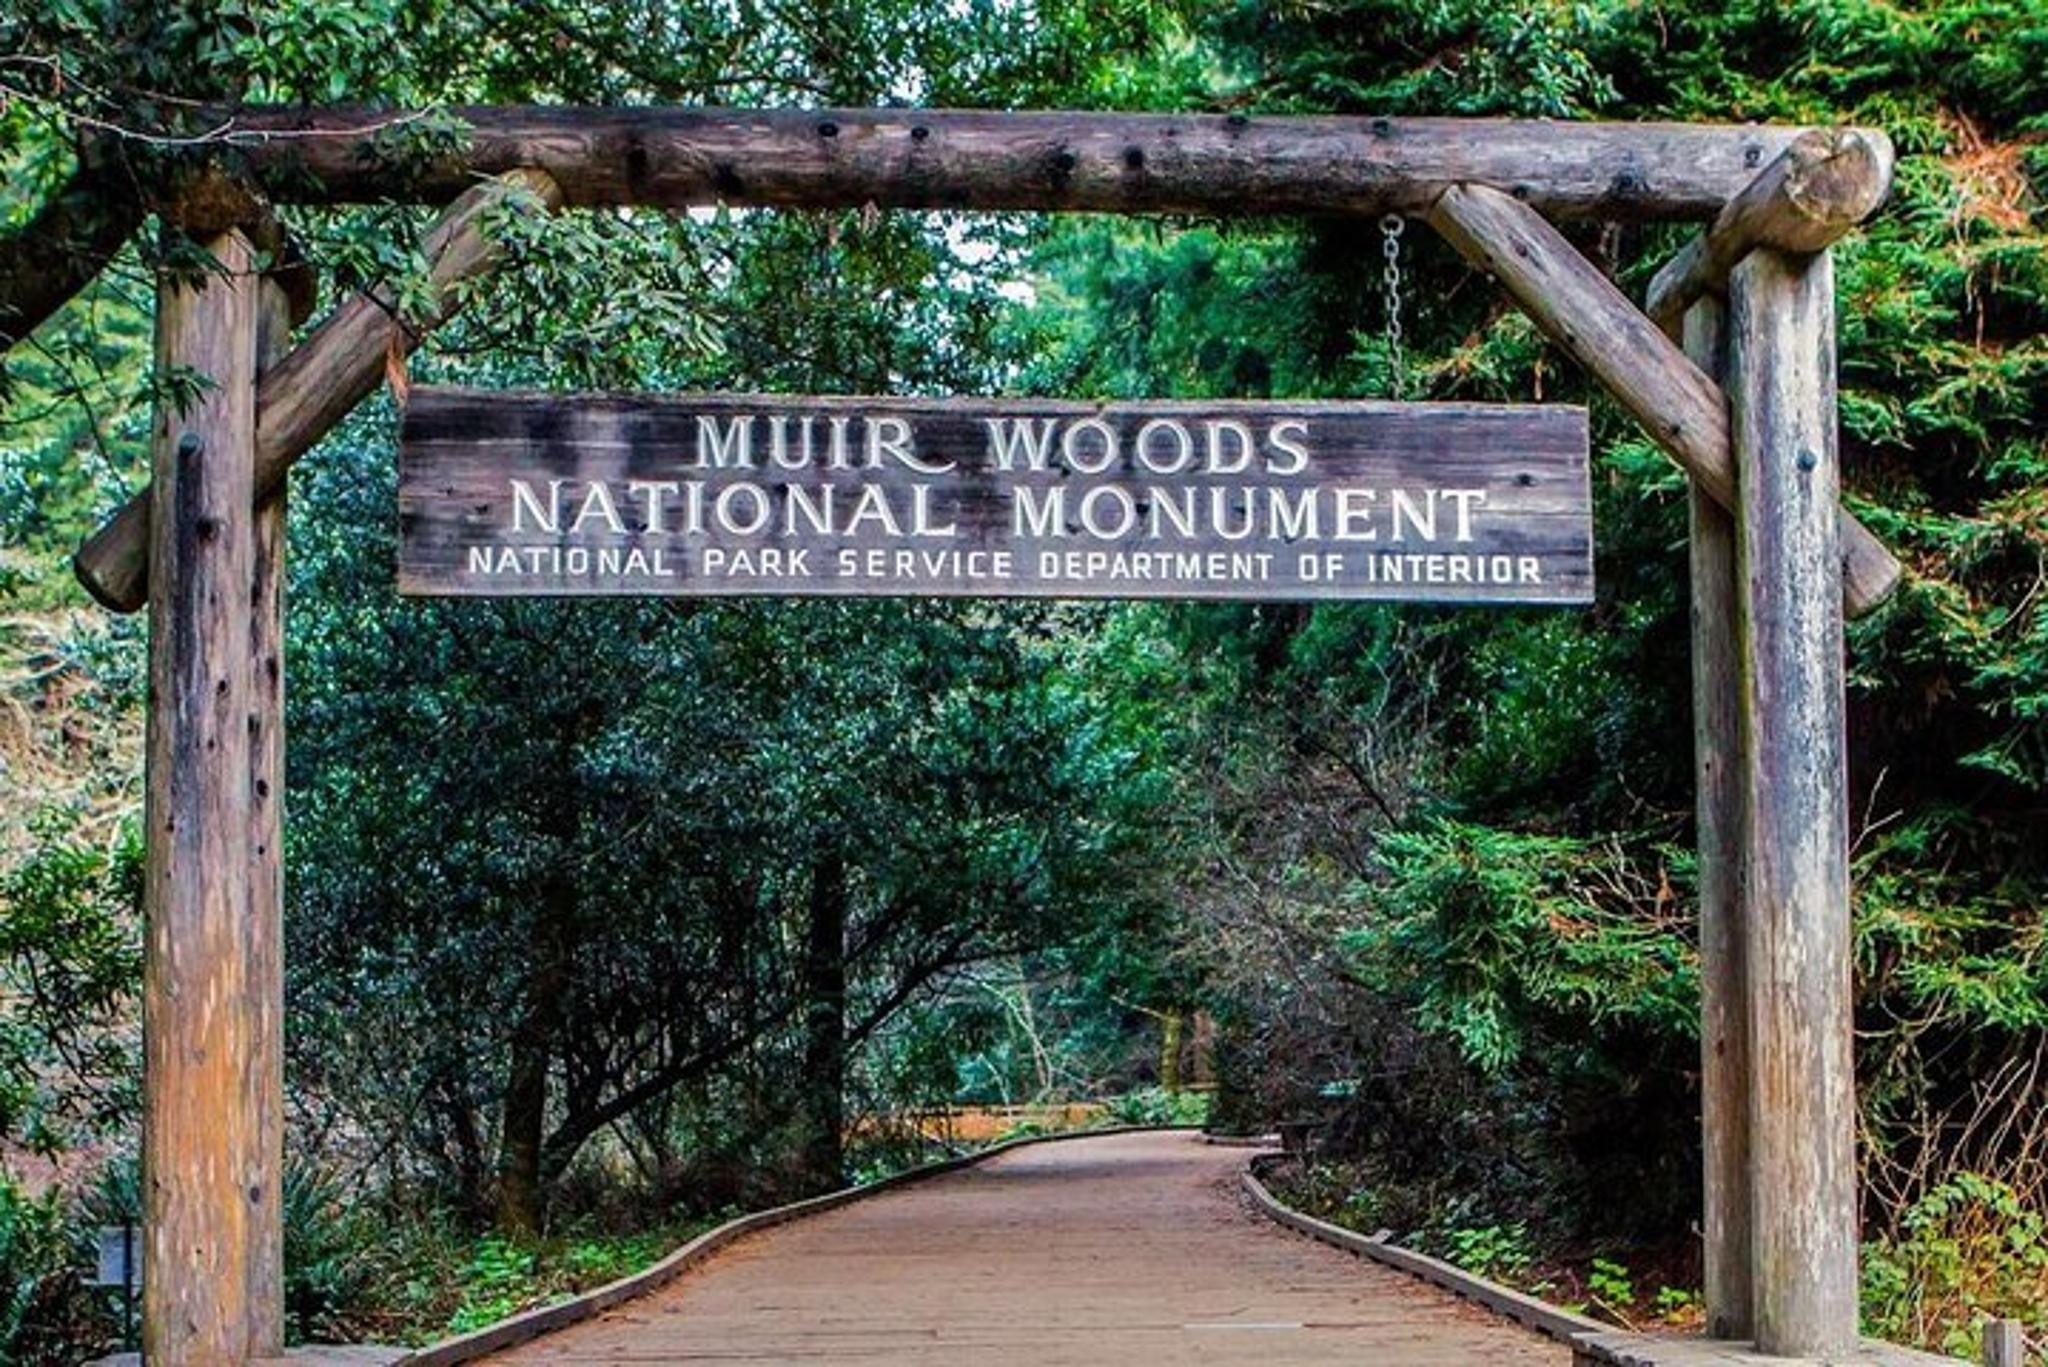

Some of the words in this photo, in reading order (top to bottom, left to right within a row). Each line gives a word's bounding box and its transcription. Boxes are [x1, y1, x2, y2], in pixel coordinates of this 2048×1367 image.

[694, 414, 957, 474] MUIR
[984, 417, 1311, 476] WOODS
[509, 478, 957, 537] NATIONAL
[1011, 485, 1489, 543] MONUMENT
[468, 545, 674, 577] NATIONAL
[703, 548, 811, 577] PARK
[837, 549, 1013, 579] SERVICE
[1039, 551, 1275, 581] DEPARTMENT
[1299, 553, 1344, 581] OF
[1367, 554, 1543, 585] INTERIOR
